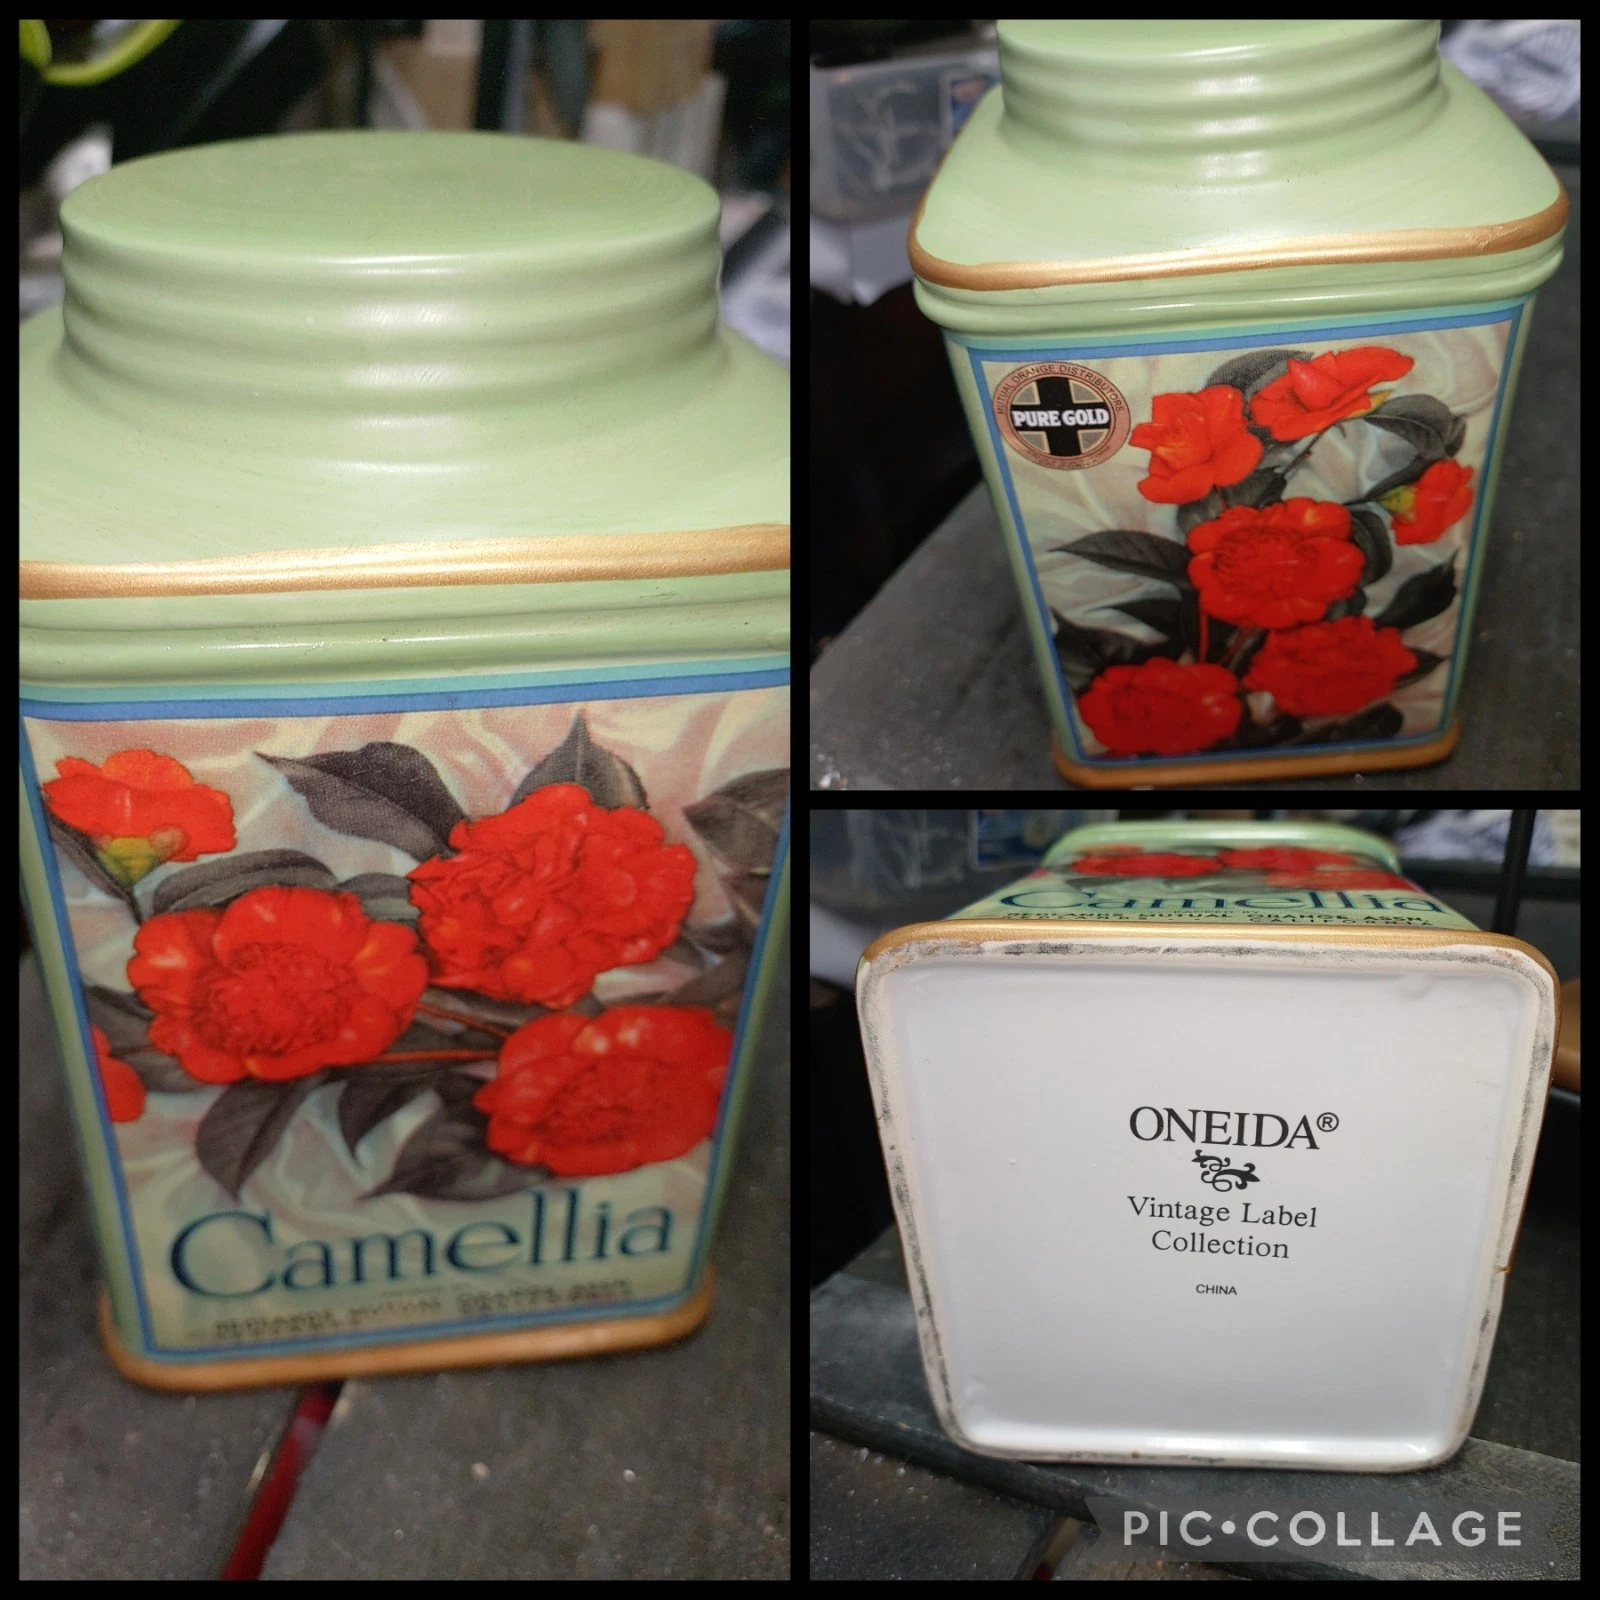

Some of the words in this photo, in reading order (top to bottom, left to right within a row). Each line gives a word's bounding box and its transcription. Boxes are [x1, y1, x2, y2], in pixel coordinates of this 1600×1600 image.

[996, 382, 1013, 415] MUTUAL
[1011, 364, 1056, 384] ORANGE
[1059, 364, 1125, 413] DISTRIBUTORS
[1011, 410, 1062, 427] PURE
[1062, 408, 1110, 427] GOLD
[1000, 891, 1446, 914] Camellia
[1127, 1195, 1230, 1226] Vintage
[1240, 1202, 1317, 1227] Label
[169, 1186, 675, 1300] Camellia
[1151, 1229, 1290, 1259] Collection
[1195, 1283, 1238, 1296] CHINA
